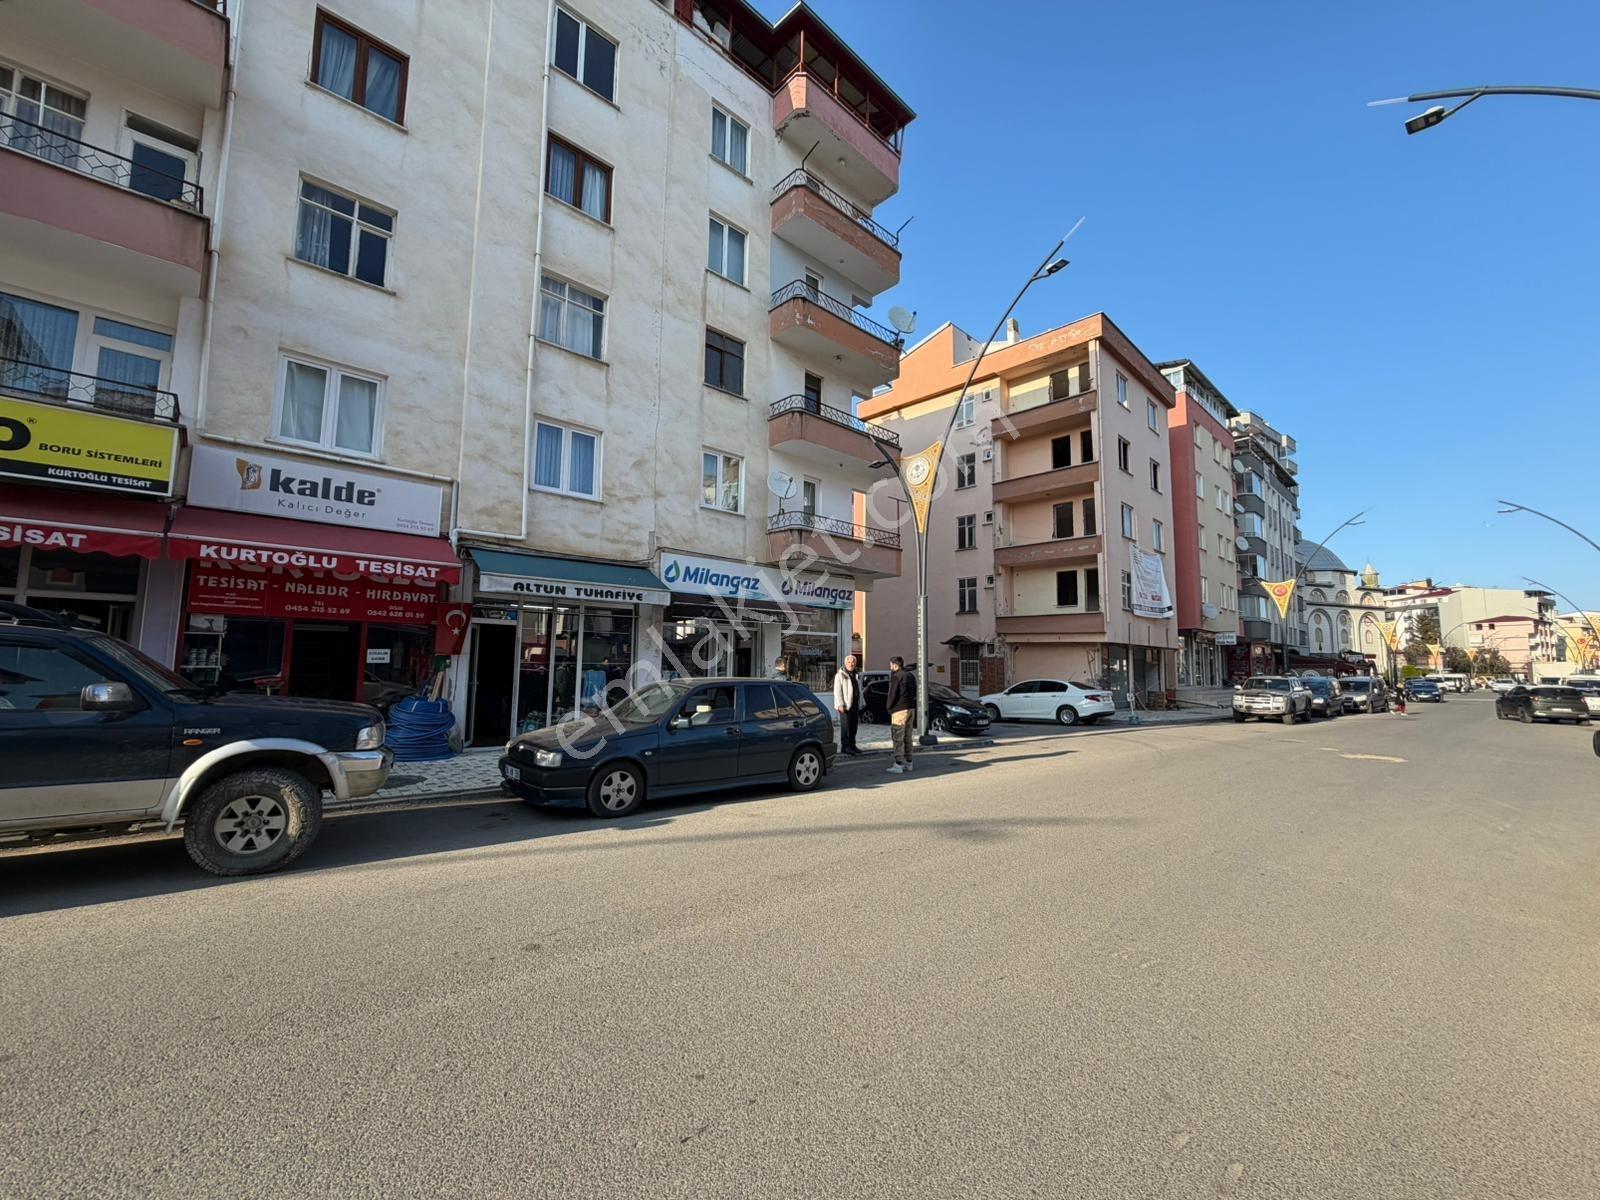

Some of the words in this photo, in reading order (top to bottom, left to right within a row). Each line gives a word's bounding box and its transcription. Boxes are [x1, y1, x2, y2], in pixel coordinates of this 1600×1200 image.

[38, 442, 82, 457] BORU
[85, 449, 162, 468] SİSTEMLERİ
[48, 467, 108, 482] KURTOĞLU
[111, 476, 152, 488] TESİSAT
[269, 468, 376, 506] kalde
[277, 499, 320, 513] Kalıcı
[325, 505, 367, 519] Değer
[200, 544, 337, 569] KURTOĞLU
[356, 559, 440, 579] TESİSAT
[196, 575, 268, 591] TESİSAT
[682, 565, 760, 594] Milangaz
[513, 582, 566, 595] ALTUN
[574, 587, 643, 601] TUHAFİYE
[794, 580, 853, 605] Milangaz
[183, 727, 221, 735] RANGER
